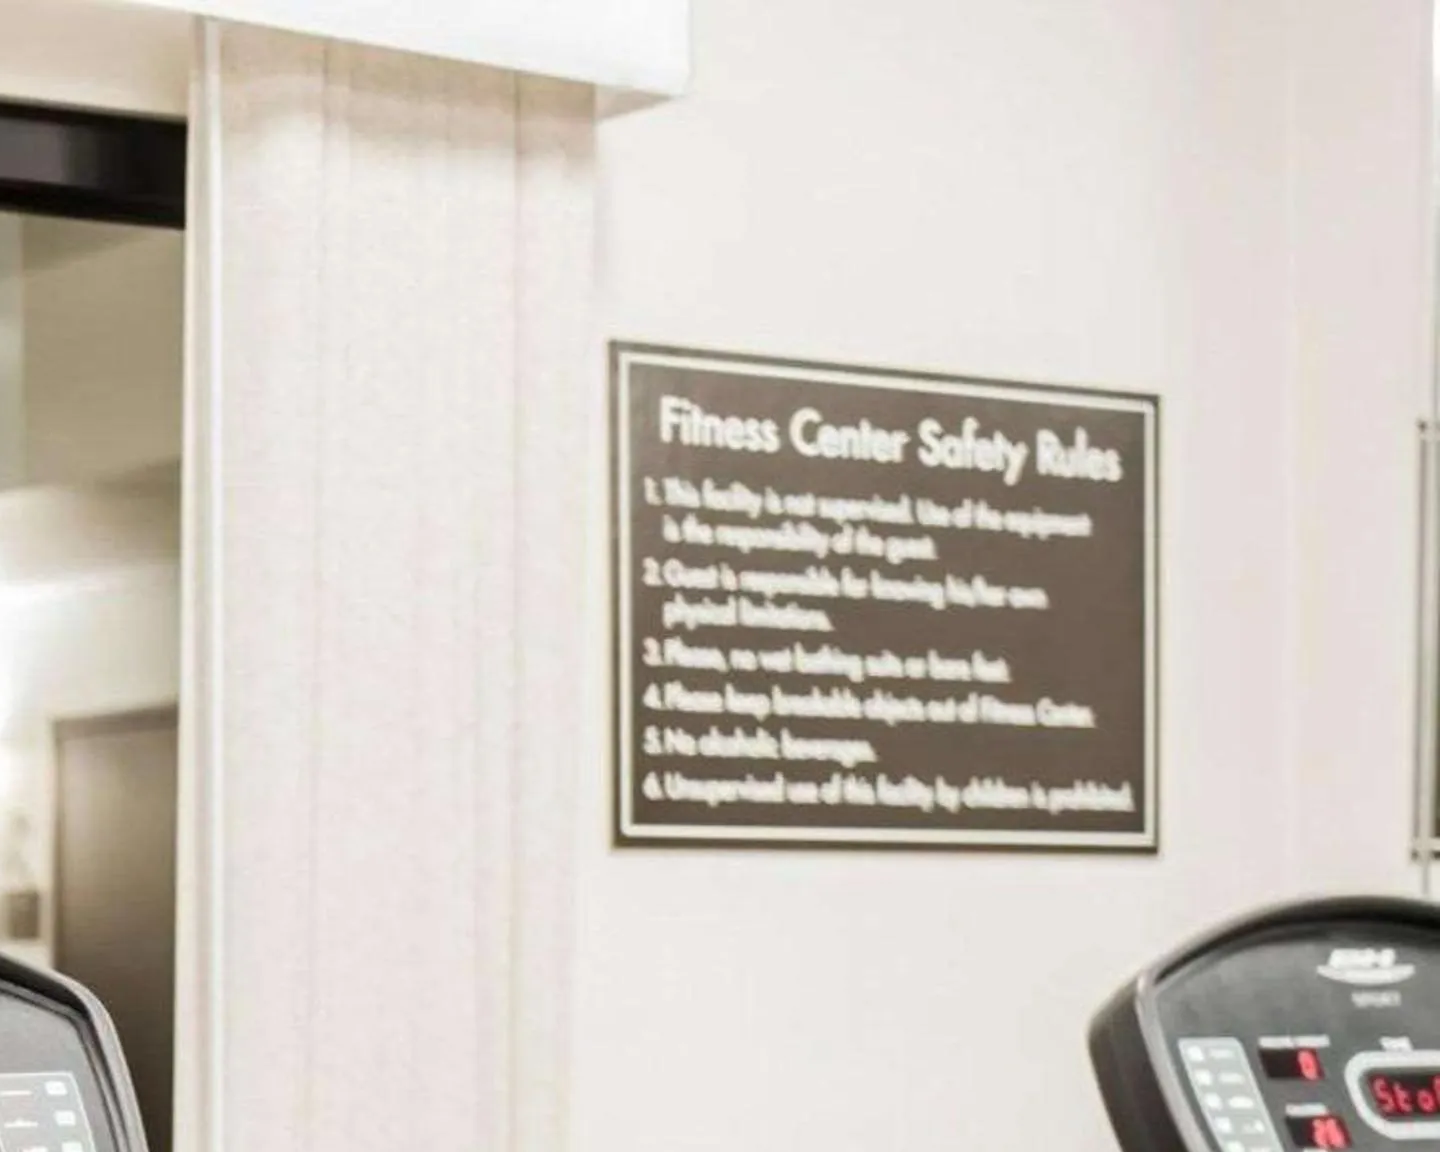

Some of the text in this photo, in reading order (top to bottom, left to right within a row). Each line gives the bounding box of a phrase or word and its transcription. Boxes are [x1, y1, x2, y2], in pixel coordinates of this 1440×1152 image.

[660, 396, 1123, 486] Fitness Center Safety Rules
[664, 727, 697, 757] No
